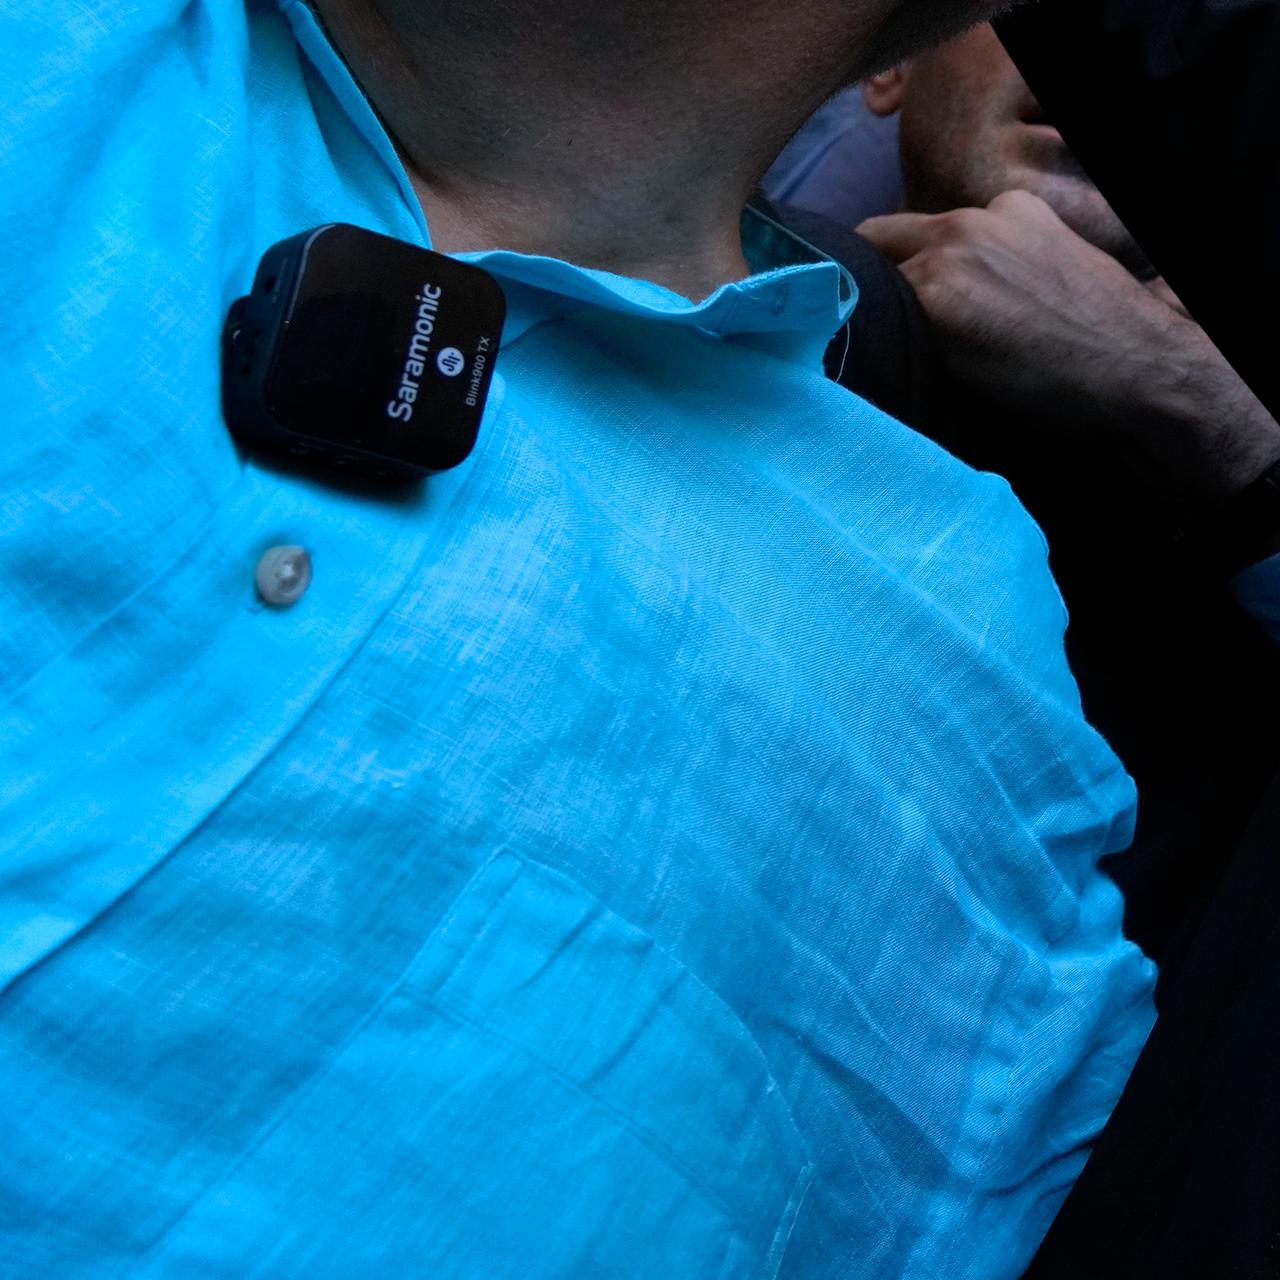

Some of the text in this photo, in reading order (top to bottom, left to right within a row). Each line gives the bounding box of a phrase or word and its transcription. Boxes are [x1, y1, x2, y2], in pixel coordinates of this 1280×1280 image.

[387, 282, 442, 423] Saramonic
[465, 336, 491, 407] Blink900 TX
